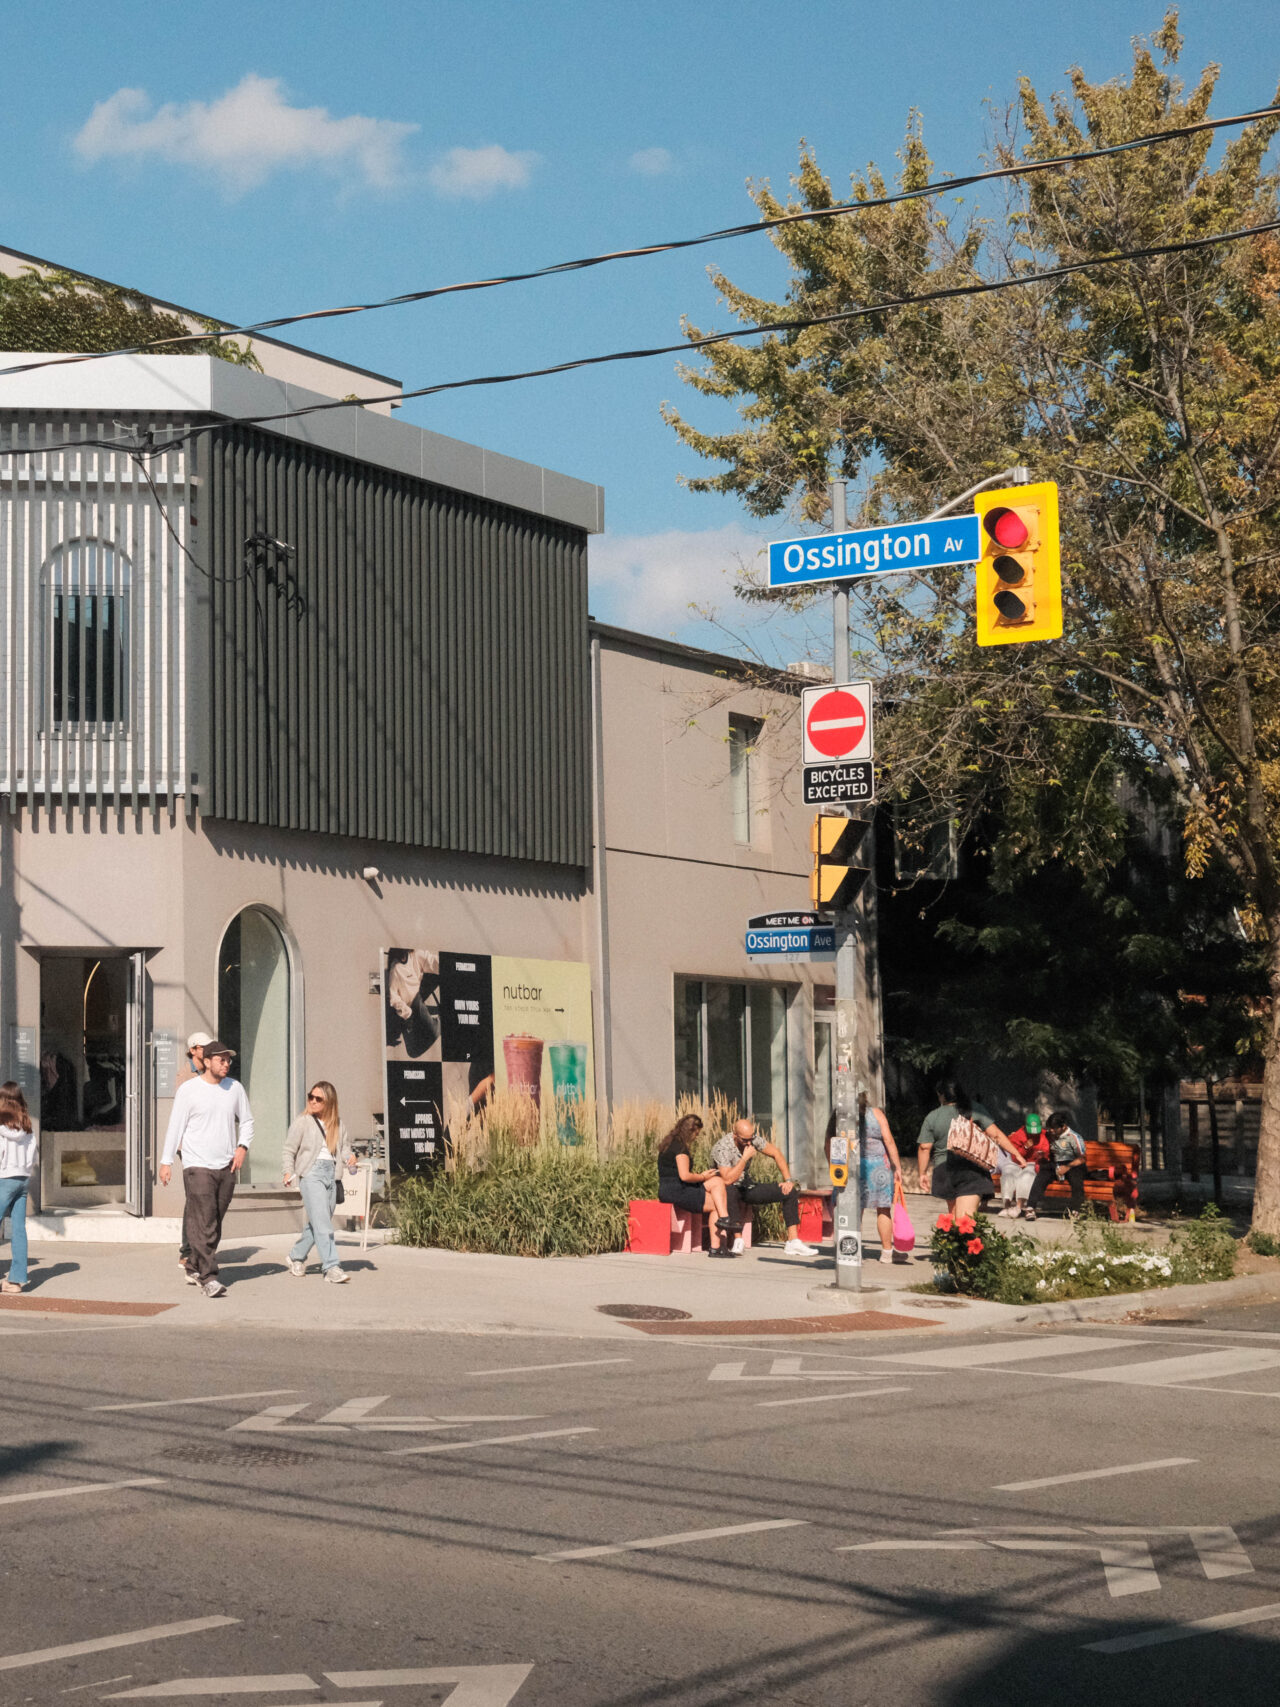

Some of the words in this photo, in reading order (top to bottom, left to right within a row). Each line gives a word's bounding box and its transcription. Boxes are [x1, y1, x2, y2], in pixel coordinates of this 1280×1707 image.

[783, 533, 931, 573] Ossington
[944, 537, 963, 553] Av
[810, 767, 865, 783] BICYCLES
[808, 782, 868, 799] EXCEPTED
[765, 917, 786, 925] MEET
[787, 916, 800, 925] ME
[802, 916, 814, 925] ON
[747, 933, 808, 951] Ossington
[814, 935, 832, 946] Ave
[503, 984, 542, 1000] nutbar
